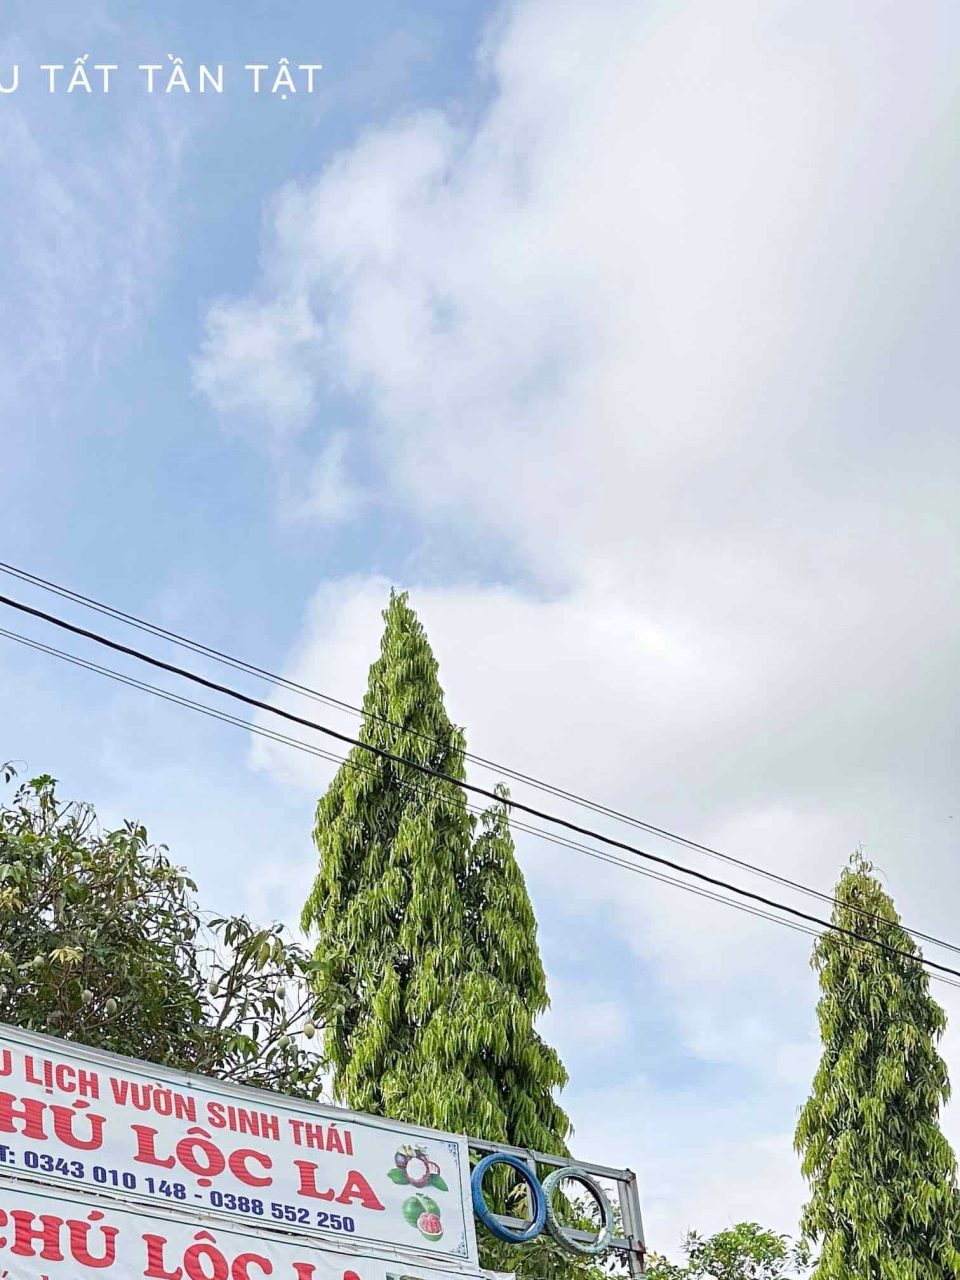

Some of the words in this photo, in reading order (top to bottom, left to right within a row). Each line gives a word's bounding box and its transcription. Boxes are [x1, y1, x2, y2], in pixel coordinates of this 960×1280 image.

[25, 1055, 100, 1099] LỊCH
[110, 1077, 197, 1122] VƯỜN
[207, 1101, 280, 1141] SINH
[288, 1119, 354, 1156] THÁI
[24, 1150, 85, 1178] 0343
[93, 1166, 137, 1190] 010
[145, 1177, 186, 1200] 148
[210, 1190, 264, 1216] 0388
[271, 1202, 310, 1225] 552
[317, 1212, 355, 1233] 250
[131, 1124, 273, 1187] LỘC
[293, 1160, 385, 1211] LA
